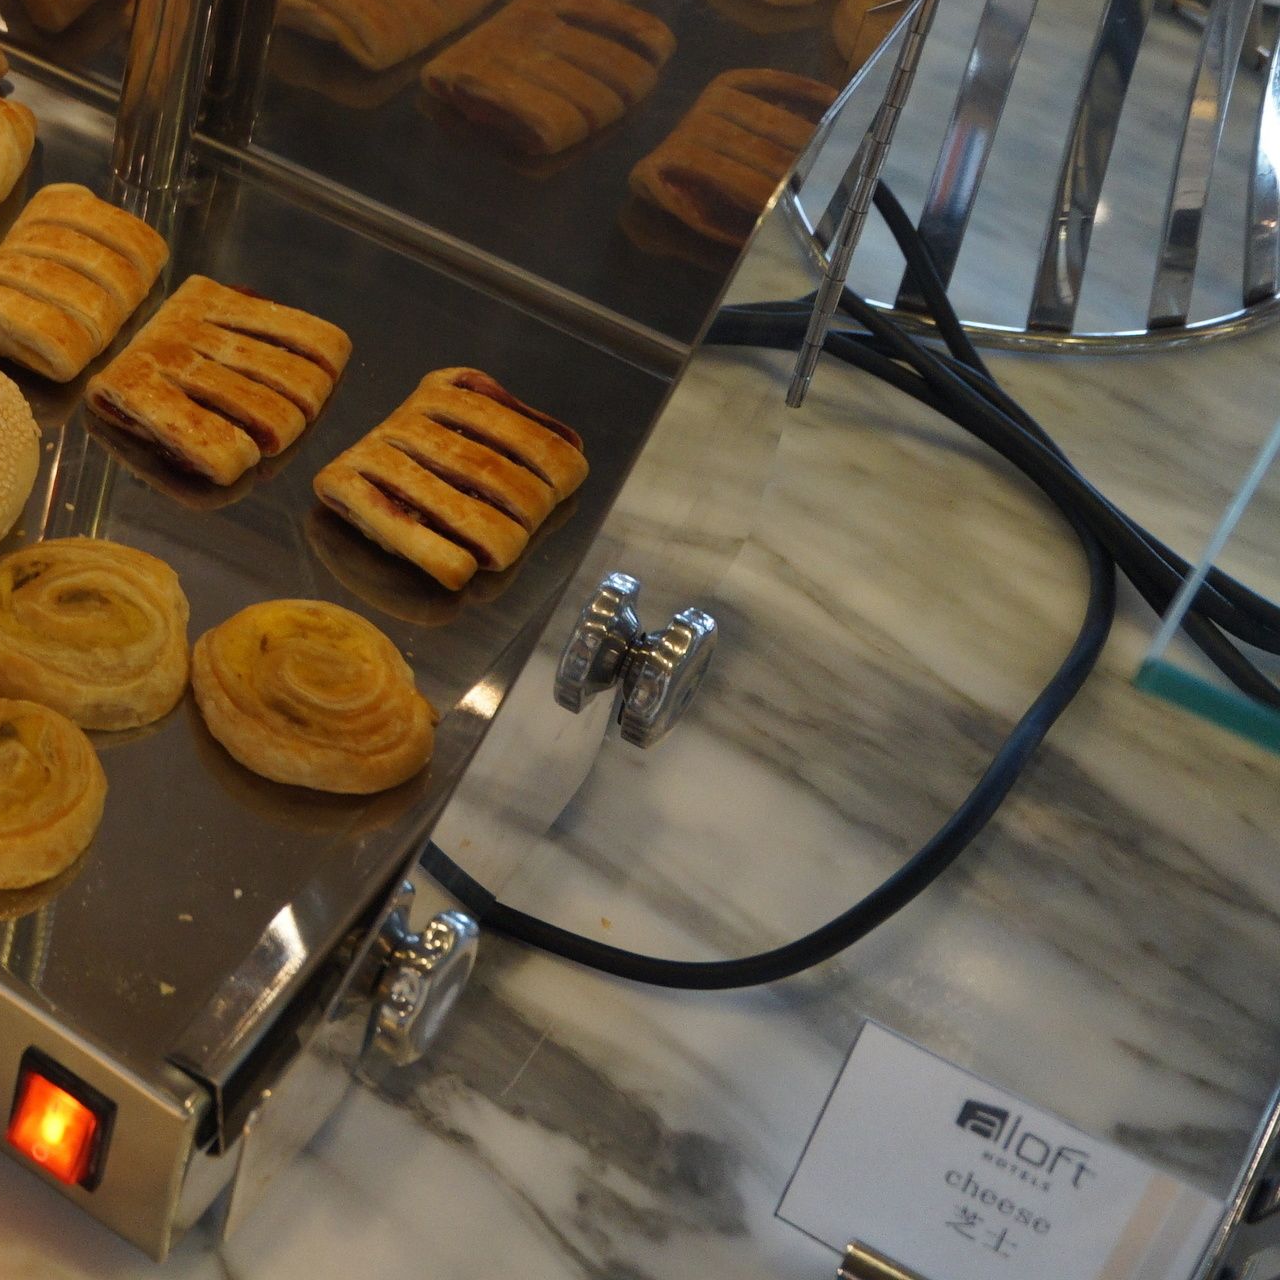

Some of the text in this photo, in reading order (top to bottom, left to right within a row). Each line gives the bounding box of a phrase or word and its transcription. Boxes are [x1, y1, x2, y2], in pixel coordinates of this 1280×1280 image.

[955, 1099, 1097, 1189] aloft
[944, 1170, 1052, 1235] cheese
[944, 1205, 1018, 1259] 芝士
